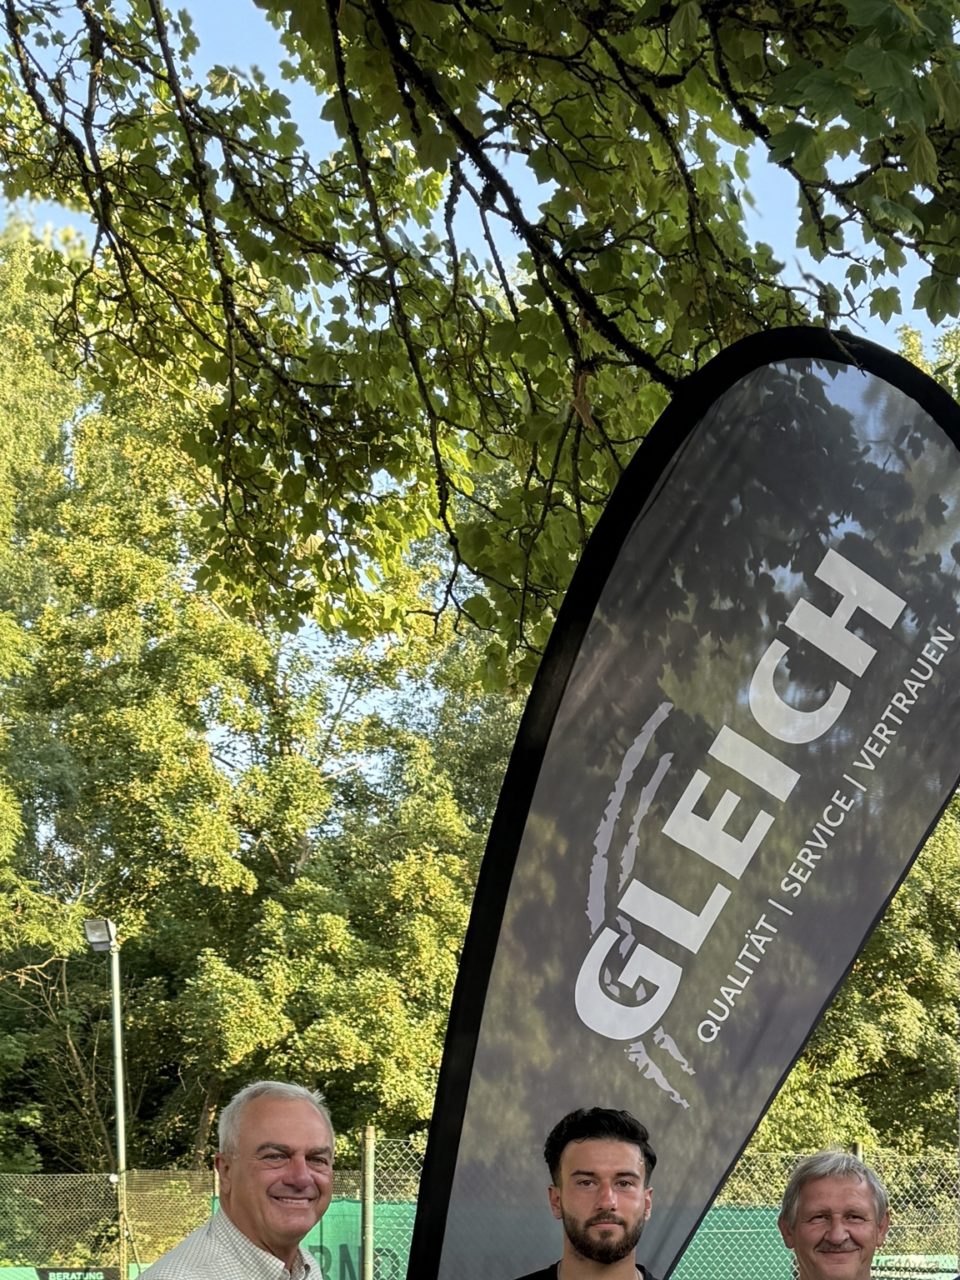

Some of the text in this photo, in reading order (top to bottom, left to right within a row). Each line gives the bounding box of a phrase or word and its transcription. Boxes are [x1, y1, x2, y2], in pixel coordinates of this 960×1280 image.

[574, 548, 907, 1041] GLEICH
[696, 913, 780, 1044] QUALITÄT
[779, 787, 855, 899] SERVICE
[853, 625, 956, 777] VERTRAUEN
[48, 1272, 104, 1280] BERATUNG
